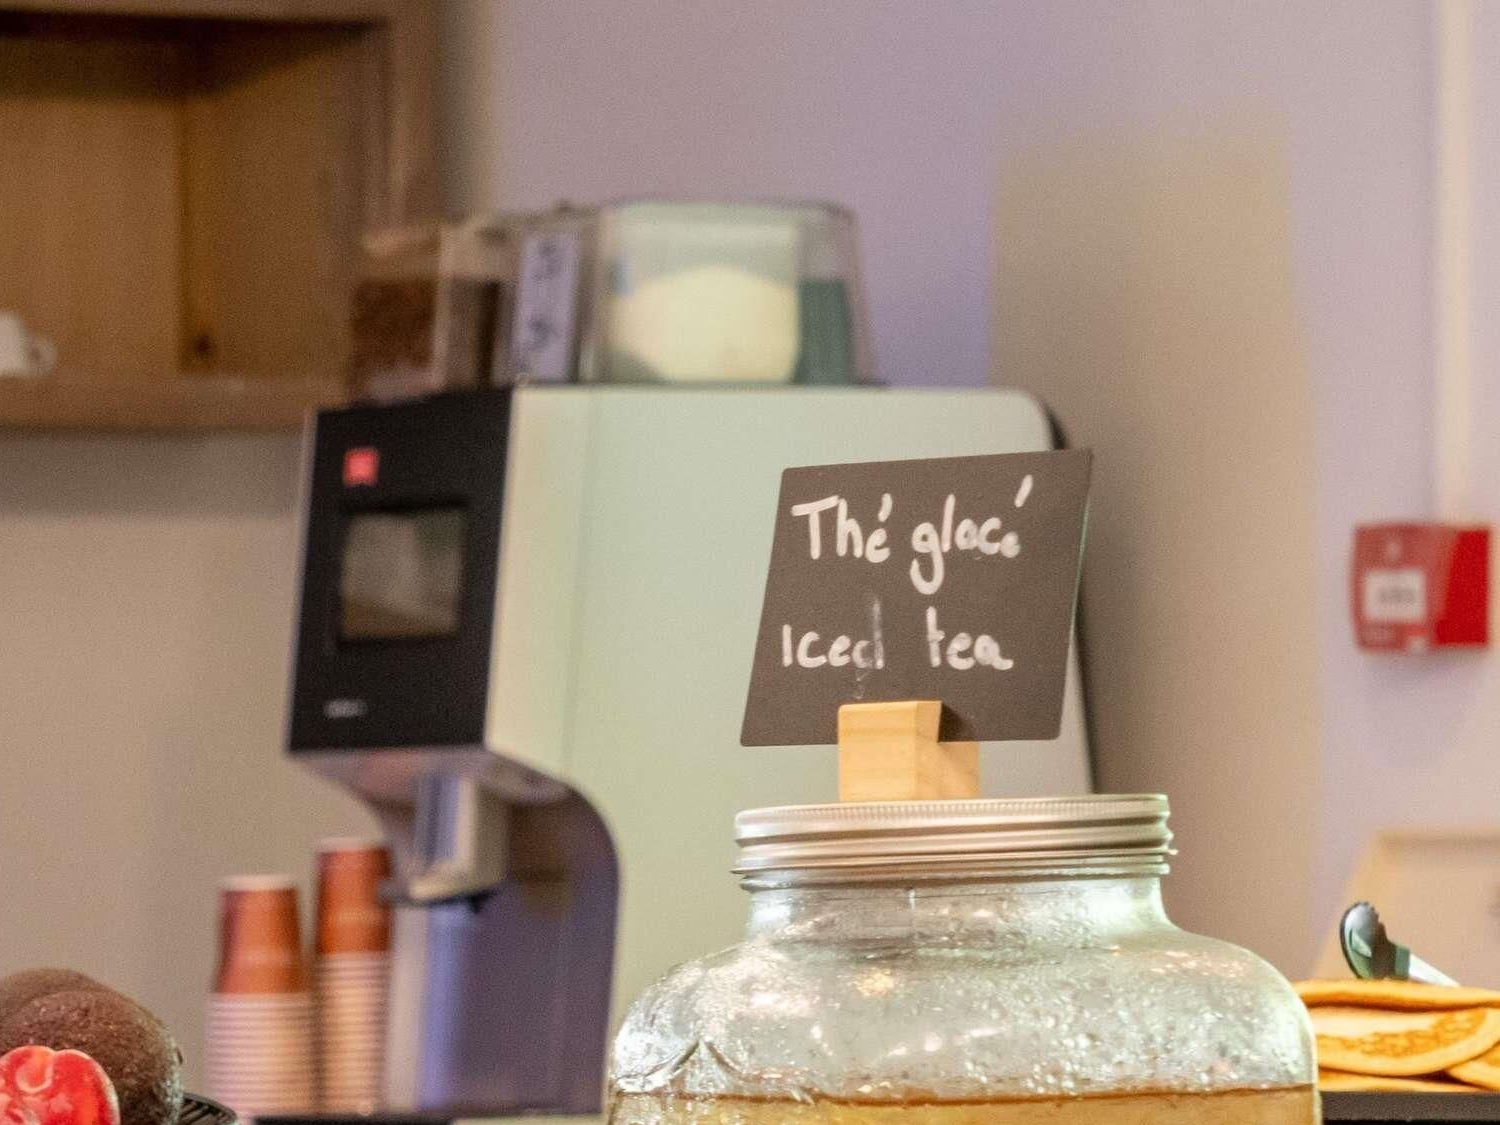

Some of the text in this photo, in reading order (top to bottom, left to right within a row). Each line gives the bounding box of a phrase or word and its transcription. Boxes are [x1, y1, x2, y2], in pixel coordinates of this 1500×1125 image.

[791, 474, 1034, 595] Thé glacé
[782, 596, 1015, 672] Iced tea
